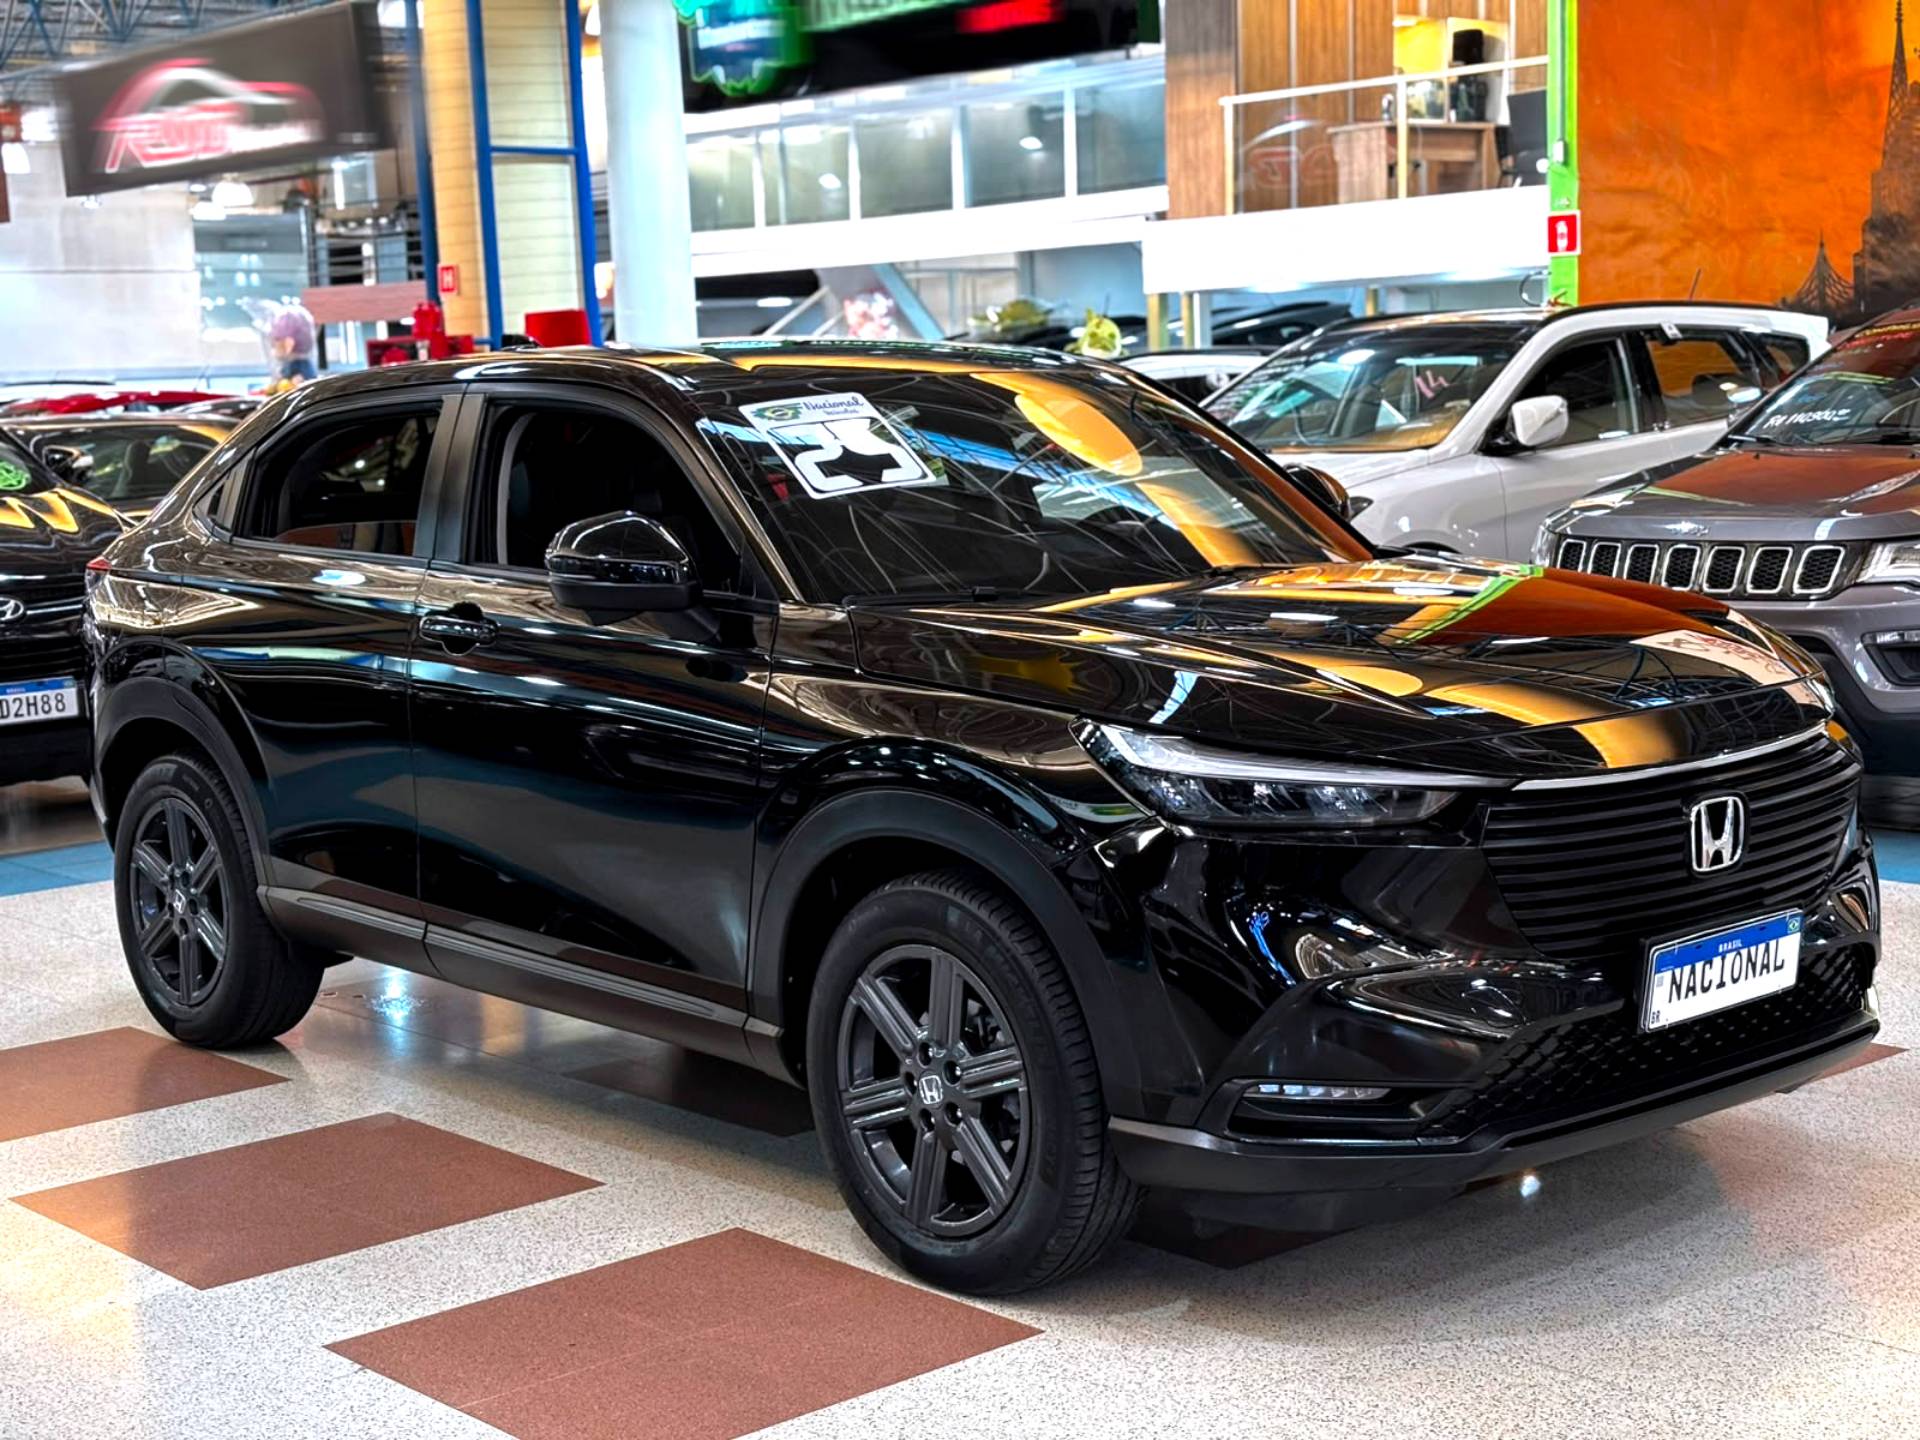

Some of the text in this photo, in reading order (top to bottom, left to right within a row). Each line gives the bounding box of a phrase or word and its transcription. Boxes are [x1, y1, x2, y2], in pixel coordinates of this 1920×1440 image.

[802, 396, 864, 411] Nacional
[0, 692, 66, 719] D2H88
[1718, 939, 1743, 953] BRASIL
[1668, 940, 1785, 1003] NACIONAL
